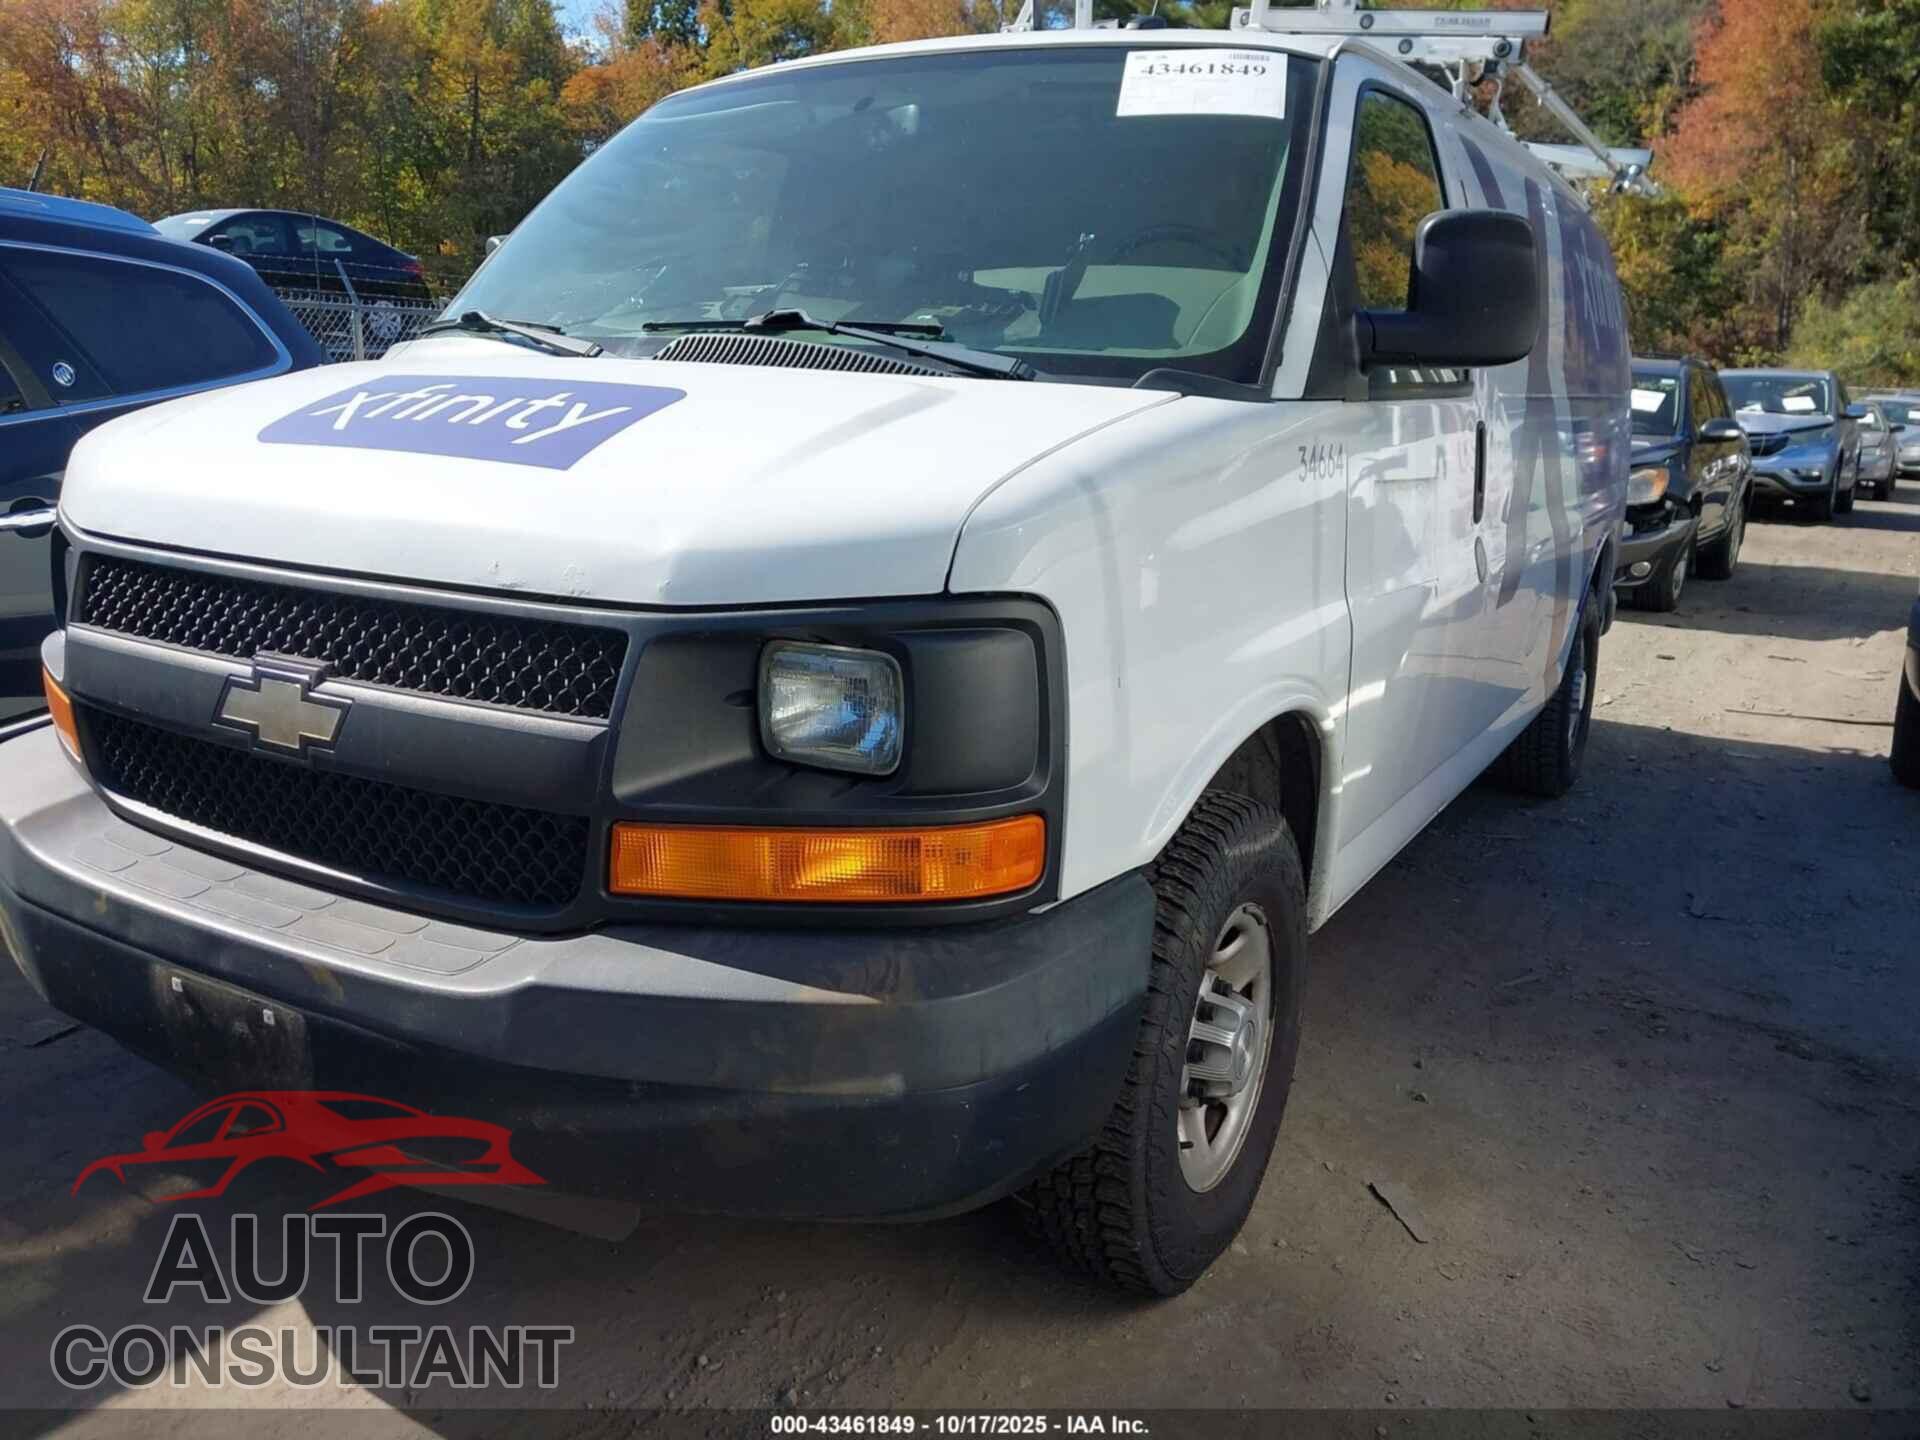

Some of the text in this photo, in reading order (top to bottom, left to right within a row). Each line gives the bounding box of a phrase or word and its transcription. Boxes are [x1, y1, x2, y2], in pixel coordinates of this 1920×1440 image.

[1140, 62, 1267, 76] 43461849
[308, 383, 633, 445] xfinity
[1298, 442, 1345, 482] 34664
